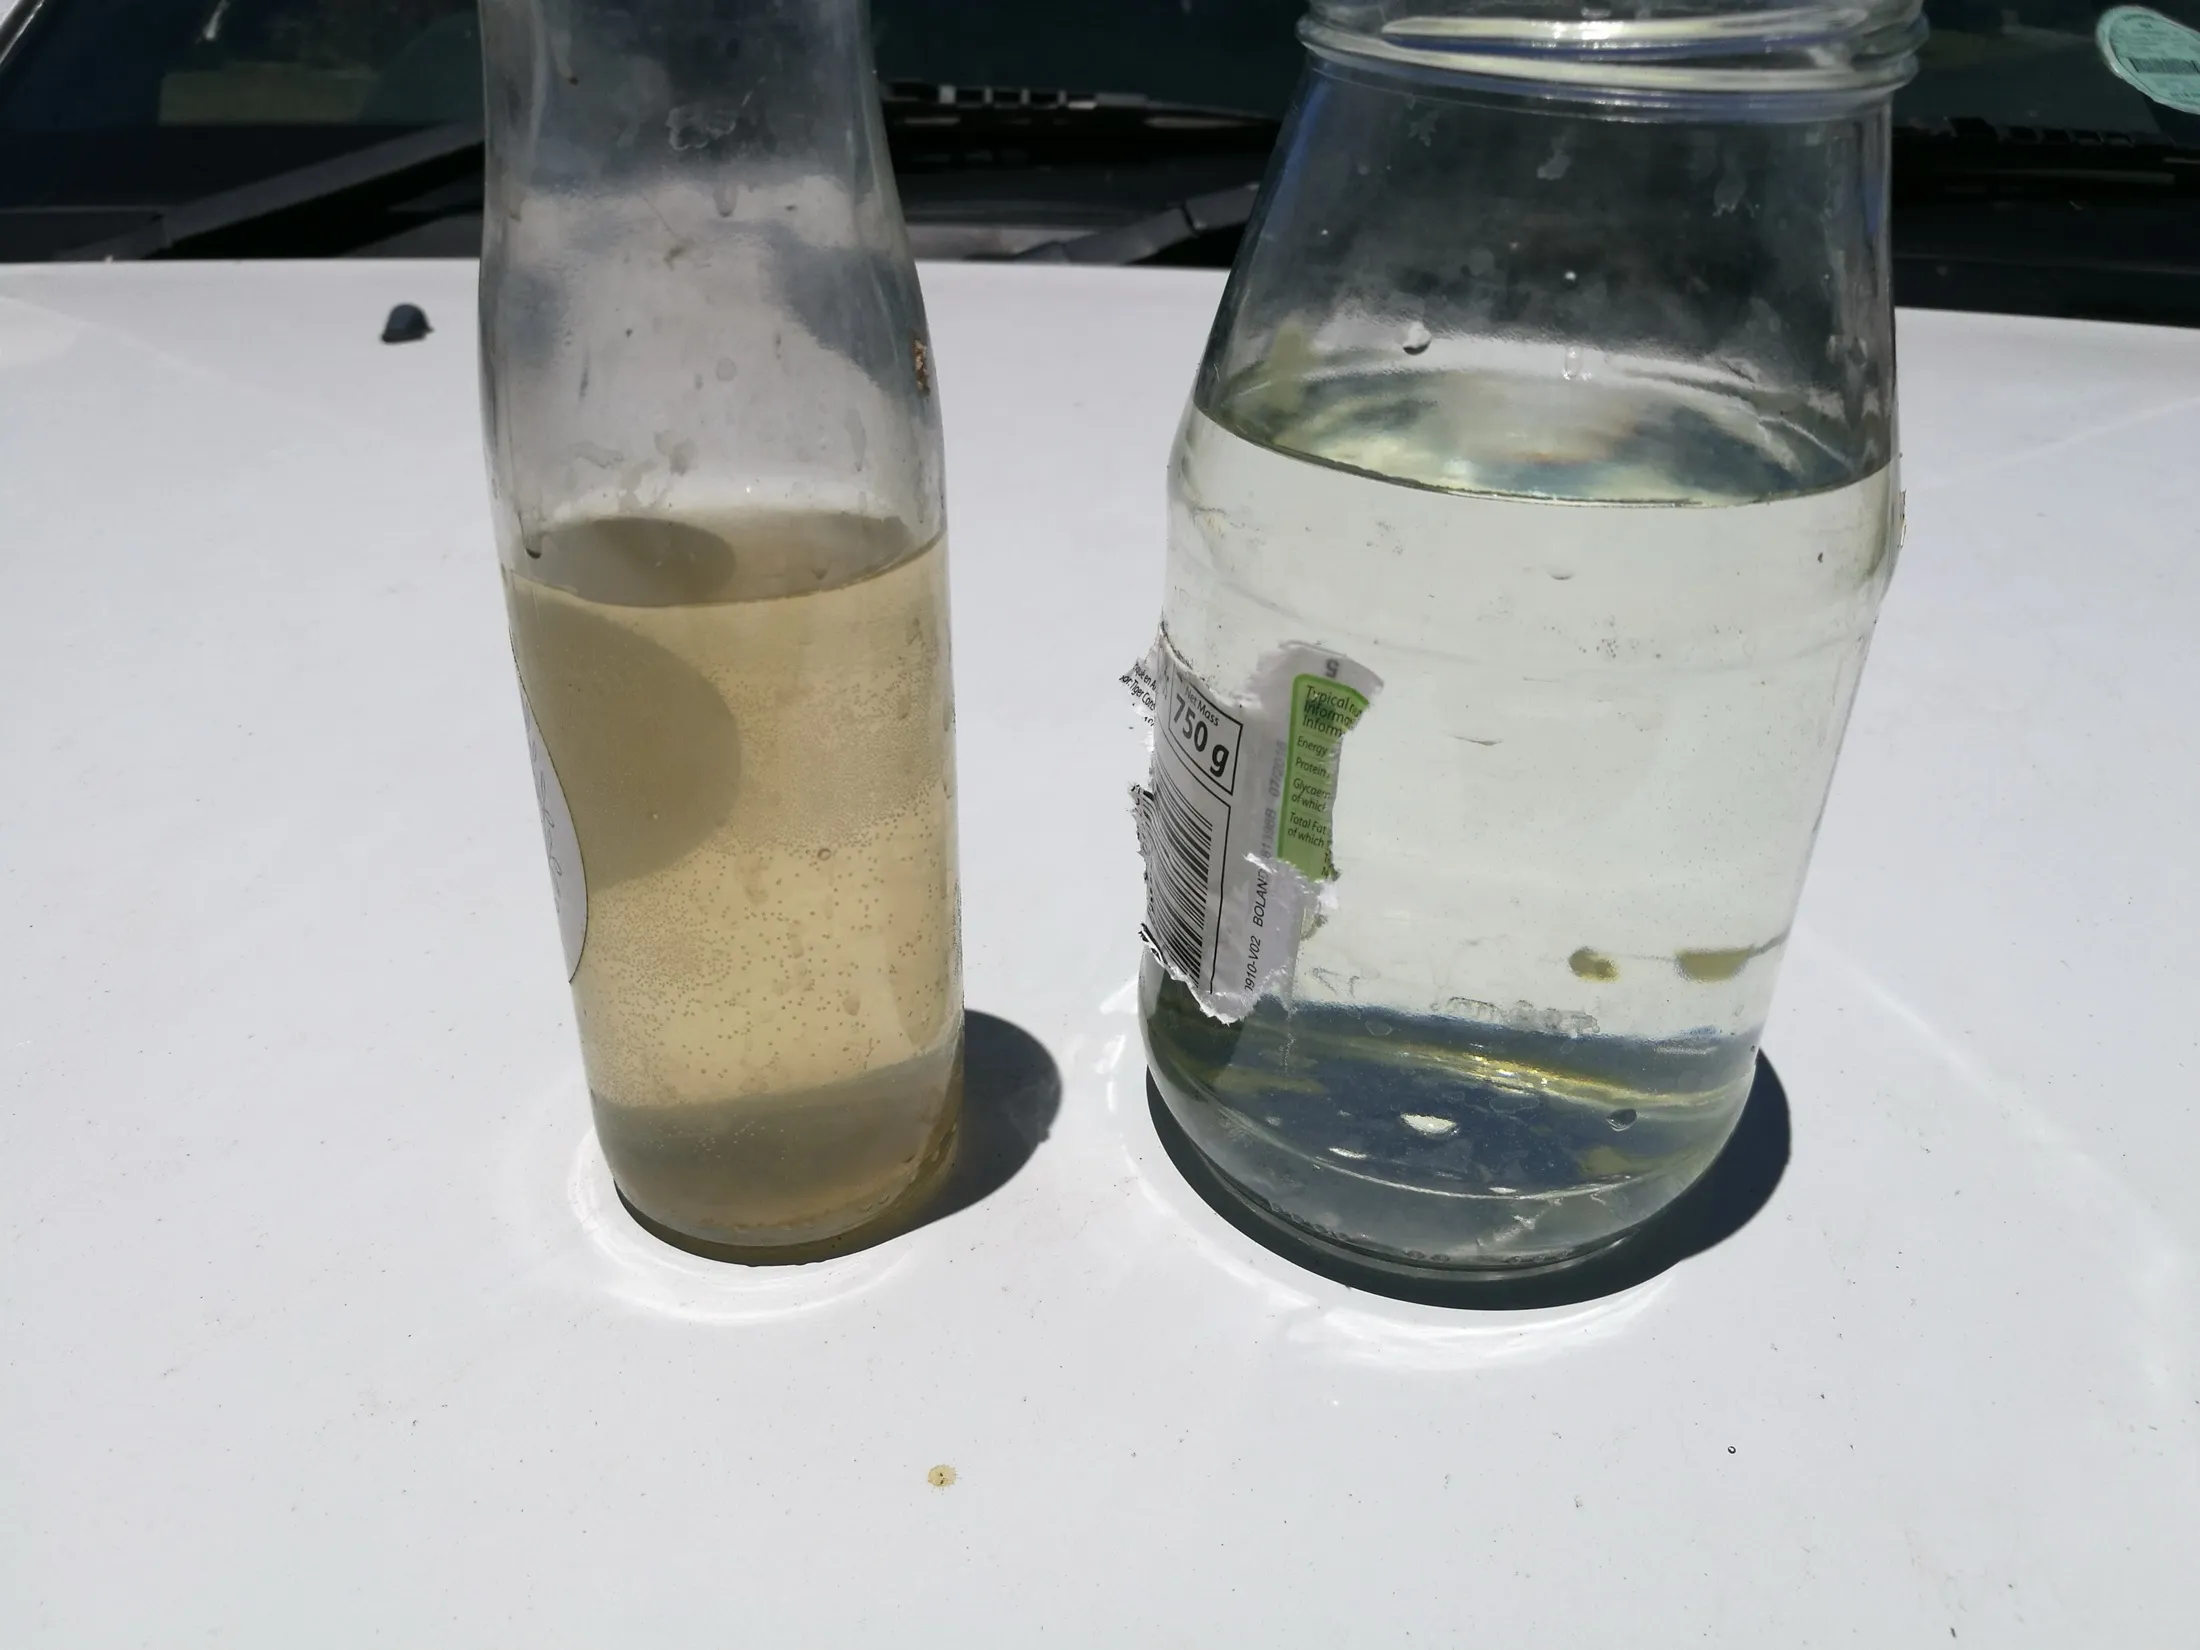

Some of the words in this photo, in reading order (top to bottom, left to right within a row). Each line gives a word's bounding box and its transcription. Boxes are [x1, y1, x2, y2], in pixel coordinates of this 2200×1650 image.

[1129, 679, 1145, 697] Tiger
[1306, 685, 1350, 711] Typical
[1184, 685, 1198, 707] Net
[1197, 700, 1220, 727] Mass
[1173, 692, 1209, 753] 750
[1209, 744, 1230, 778] g
[1296, 735, 1329, 757] Energy
[1291, 793, 1302, 803] of
[1290, 811, 1312, 829] Total
[1311, 820, 1327, 836] Fat
[1287, 827, 1298, 838] of
[1298, 832, 1325, 849] which
